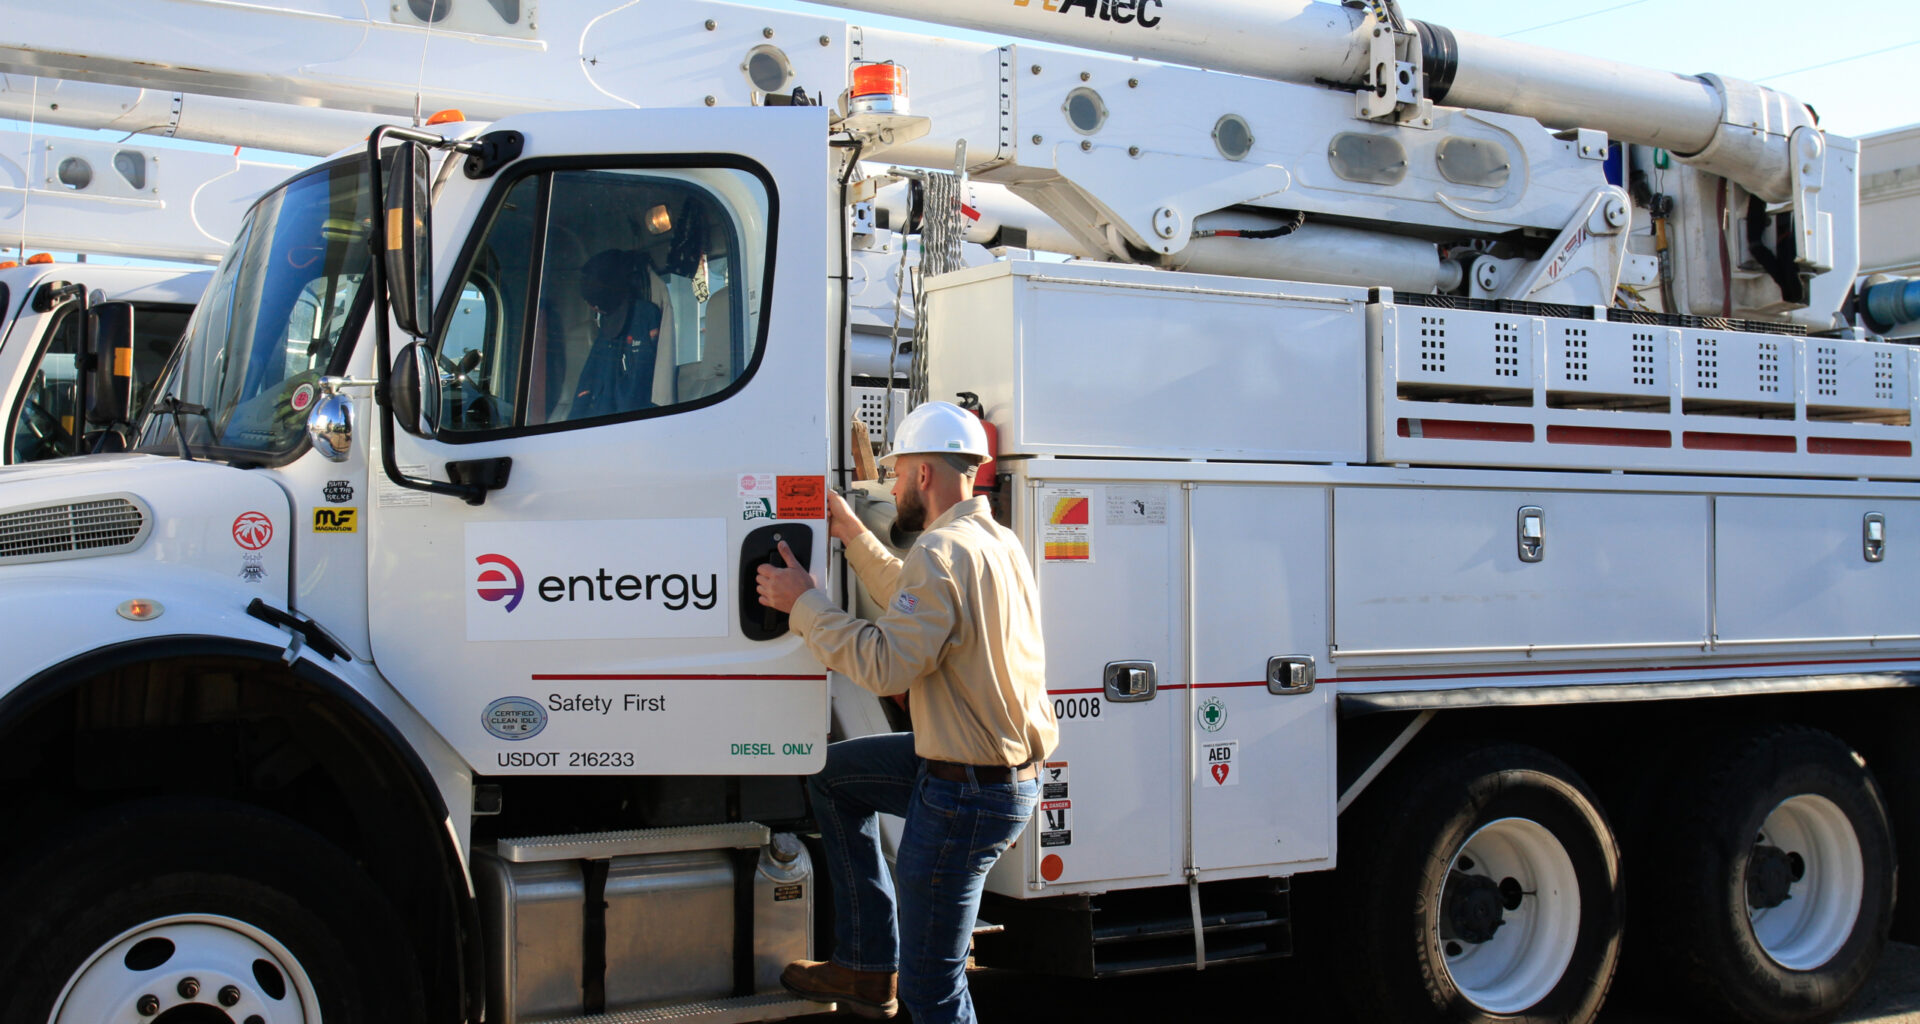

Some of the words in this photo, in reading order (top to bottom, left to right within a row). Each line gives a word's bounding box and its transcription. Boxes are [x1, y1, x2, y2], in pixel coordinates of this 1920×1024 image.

[744, 510, 766, 519] SAFETY
[538, 568, 717, 611] entergy
[548, 694, 613, 714] Safety
[624, 694, 666, 712] First
[731, 743, 776, 756] DIESEL
[782, 743, 814, 756] ONLY
[1208, 747, 1231, 761] AED
[498, 752, 560, 767] USDOT
[569, 752, 635, 767] 216233
[1048, 801, 1069, 809] DANGER
